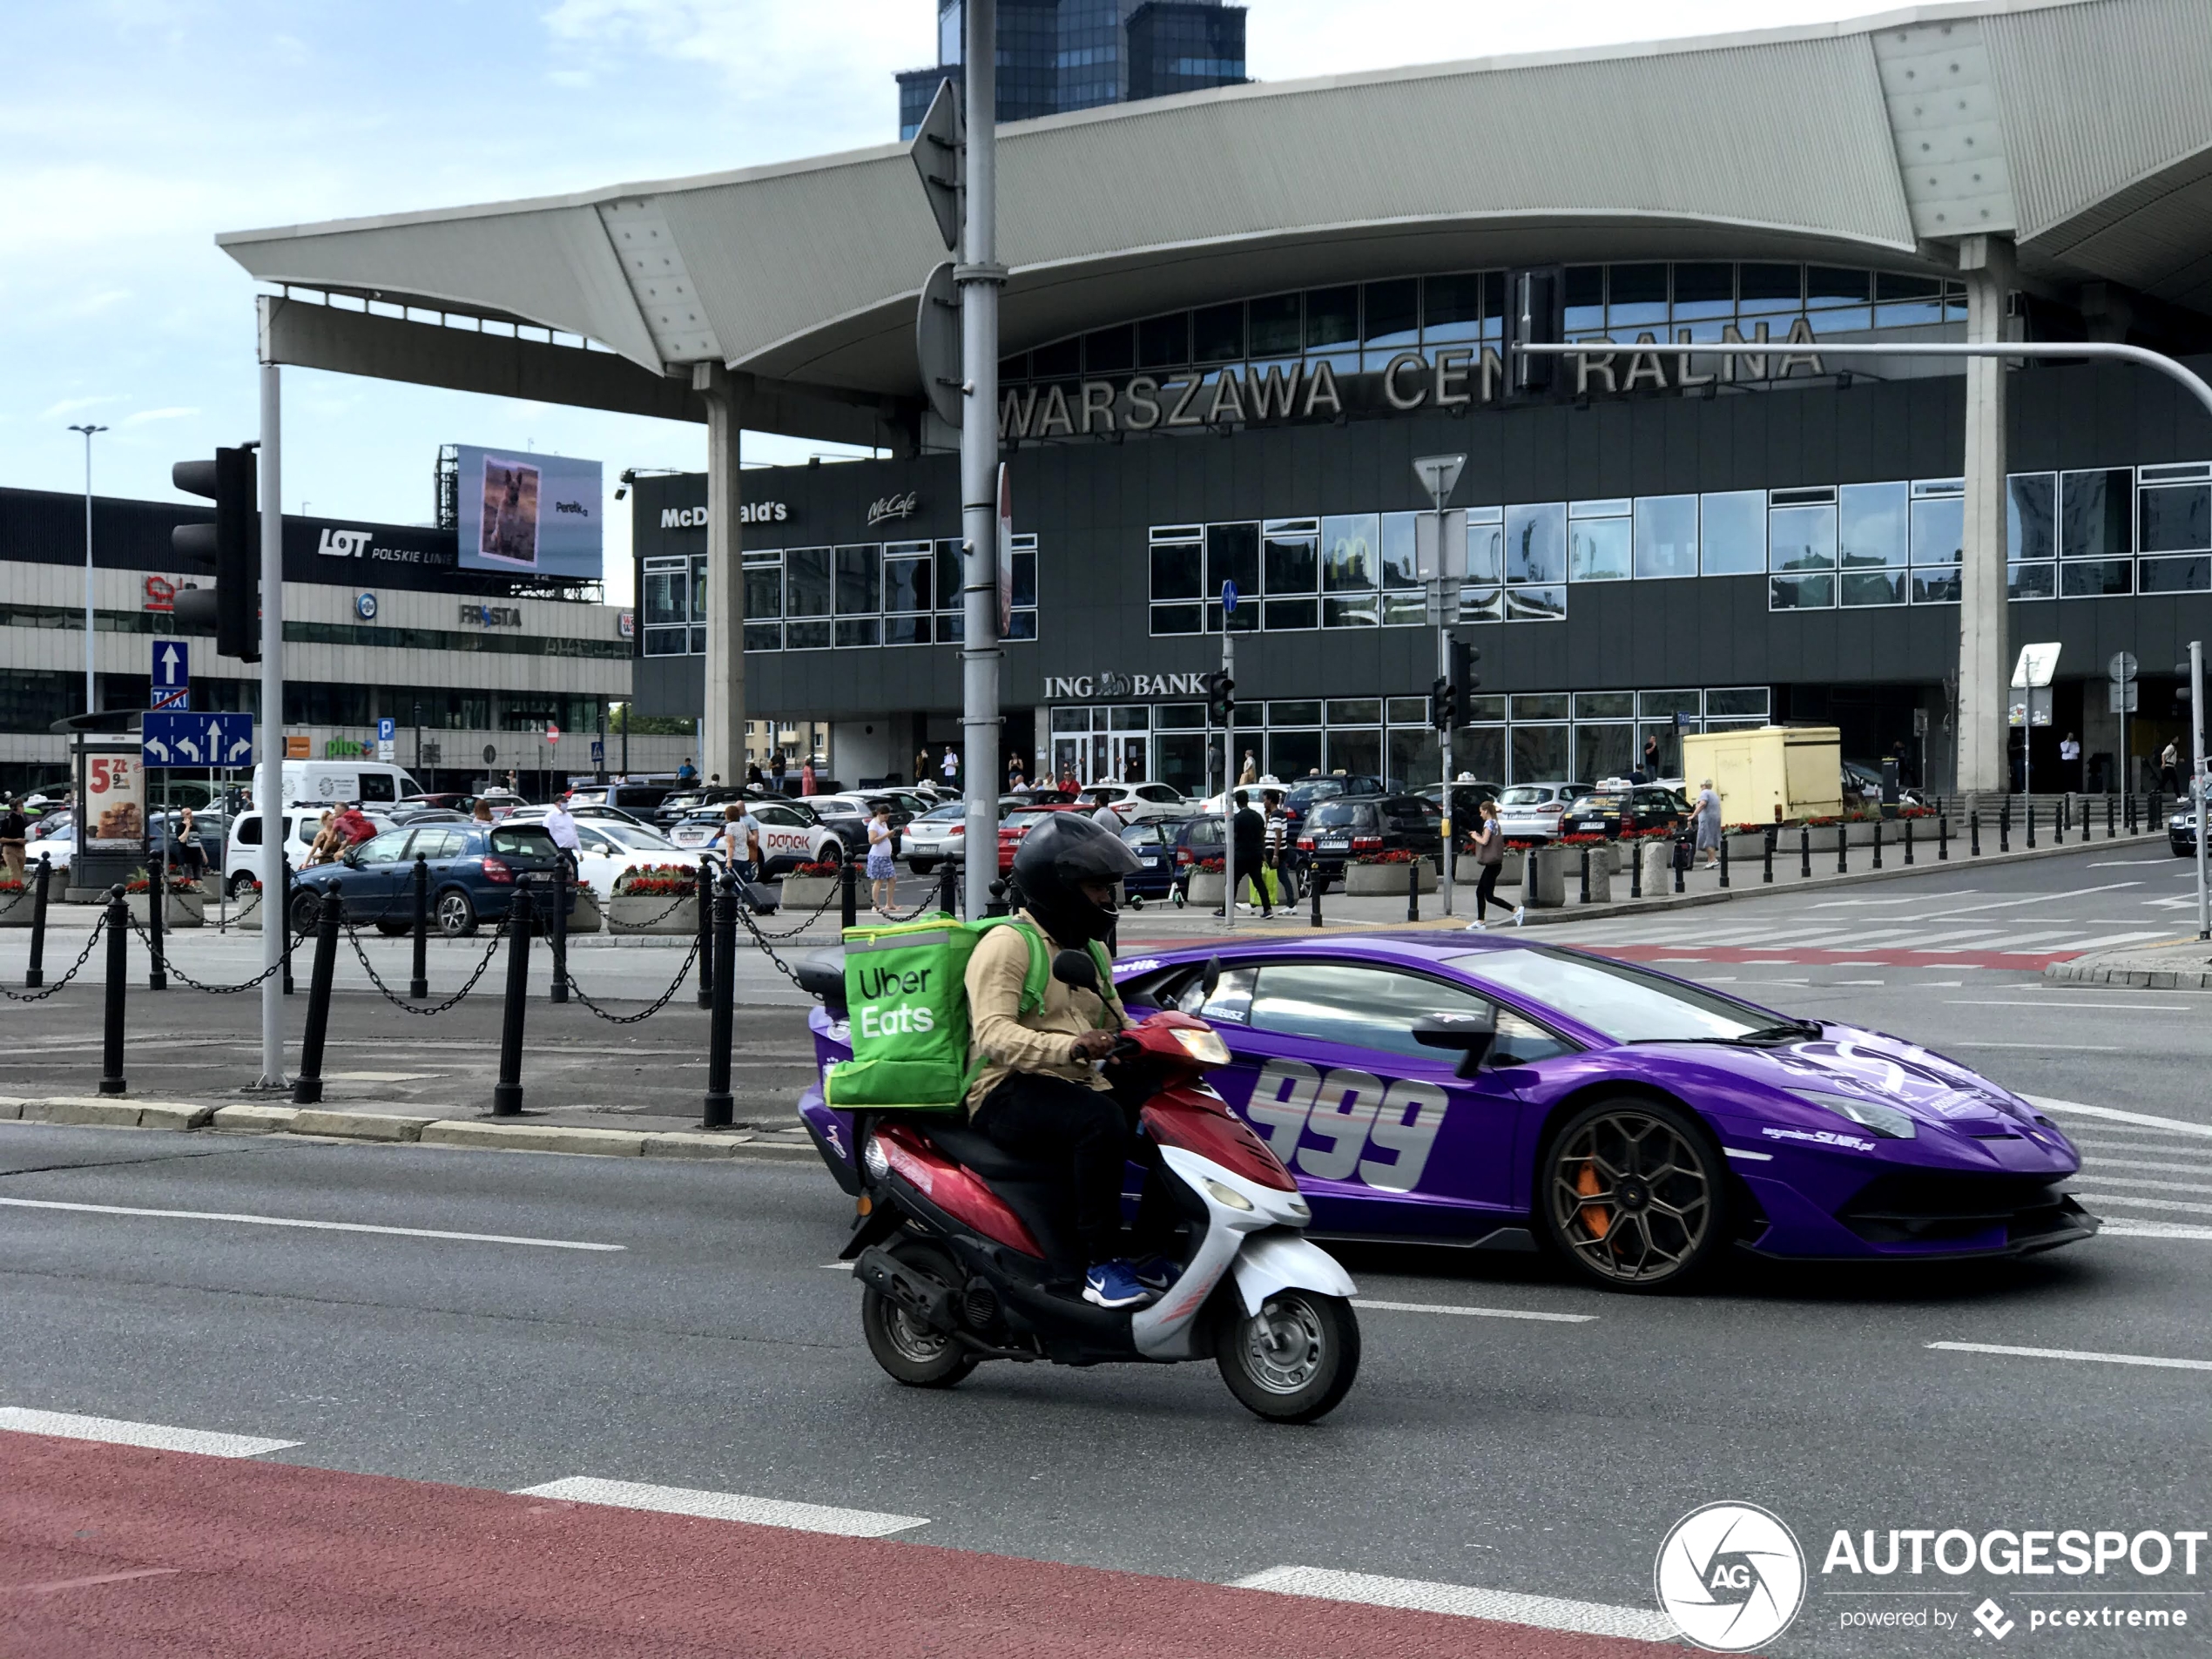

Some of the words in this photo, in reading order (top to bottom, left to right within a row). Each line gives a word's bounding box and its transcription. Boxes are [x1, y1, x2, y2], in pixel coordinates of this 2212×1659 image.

[998, 360, 1343, 437] WARSZAWA
[318, 528, 374, 558] LOT
[372, 548, 420, 563] POLSKIE
[153, 691, 187, 708] TAXI
[1044, 676, 1095, 698] ING
[1133, 672, 1209, 696] BANK
[381, 720, 392, 738] P
[327, 735, 361, 759] plus
[90, 759, 111, 794] 5
[112, 773, 121, 786] 9
[767, 833, 810, 850] panek
[859, 967, 932, 1001] Uber
[861, 1002, 934, 1038] Eats
[1246, 1057, 1450, 1194] 999
